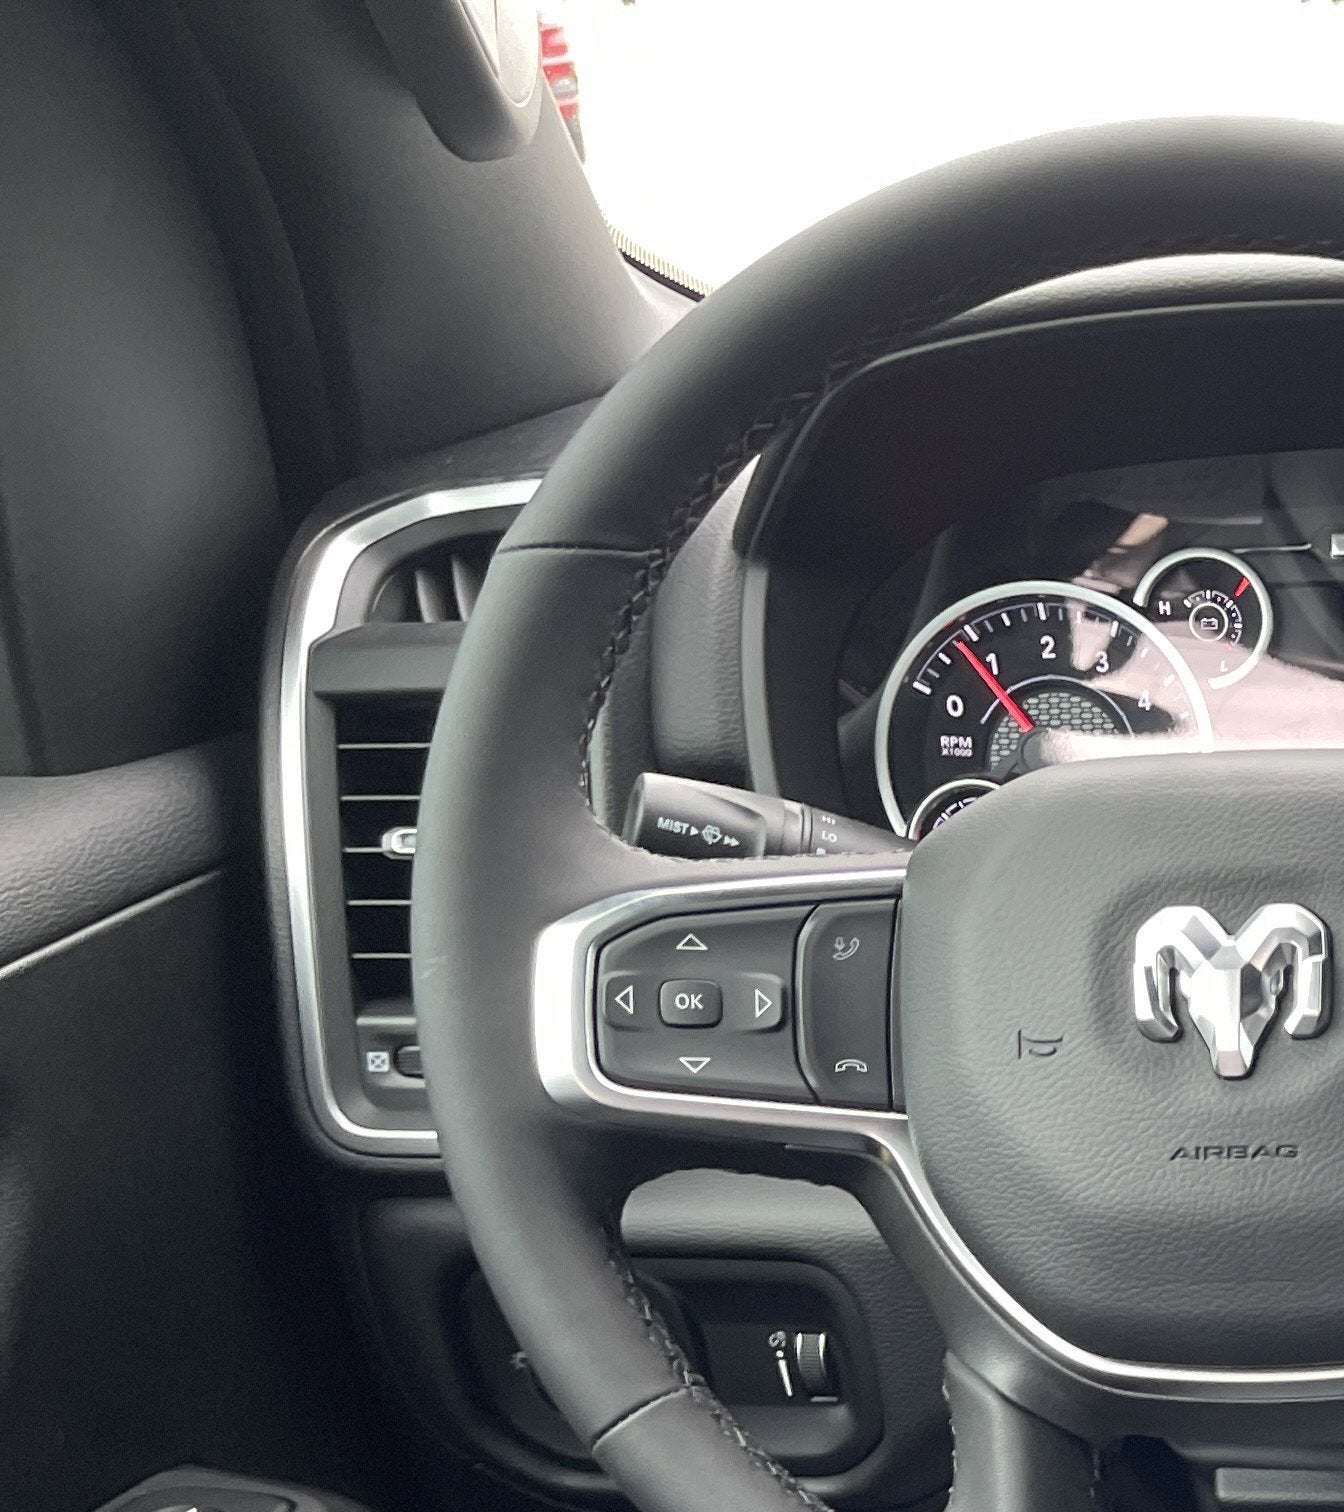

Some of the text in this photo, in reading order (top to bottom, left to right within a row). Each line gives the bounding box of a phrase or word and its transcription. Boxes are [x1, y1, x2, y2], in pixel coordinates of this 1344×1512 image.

[1159, 601, 1171, 616] H
[1040, 636, 1057, 660] 2
[985, 652, 998, 676] 1
[1096, 651, 1110, 674] 3
[946, 694, 964, 718] 0
[1137, 689, 1151, 711] 4
[940, 735, 973, 748] RPM
[657, 815, 690, 836] MIST
[821, 830, 838, 844] LO
[673, 991, 704, 1012] OK
[1169, 1144, 1299, 1161] AIRBAG
